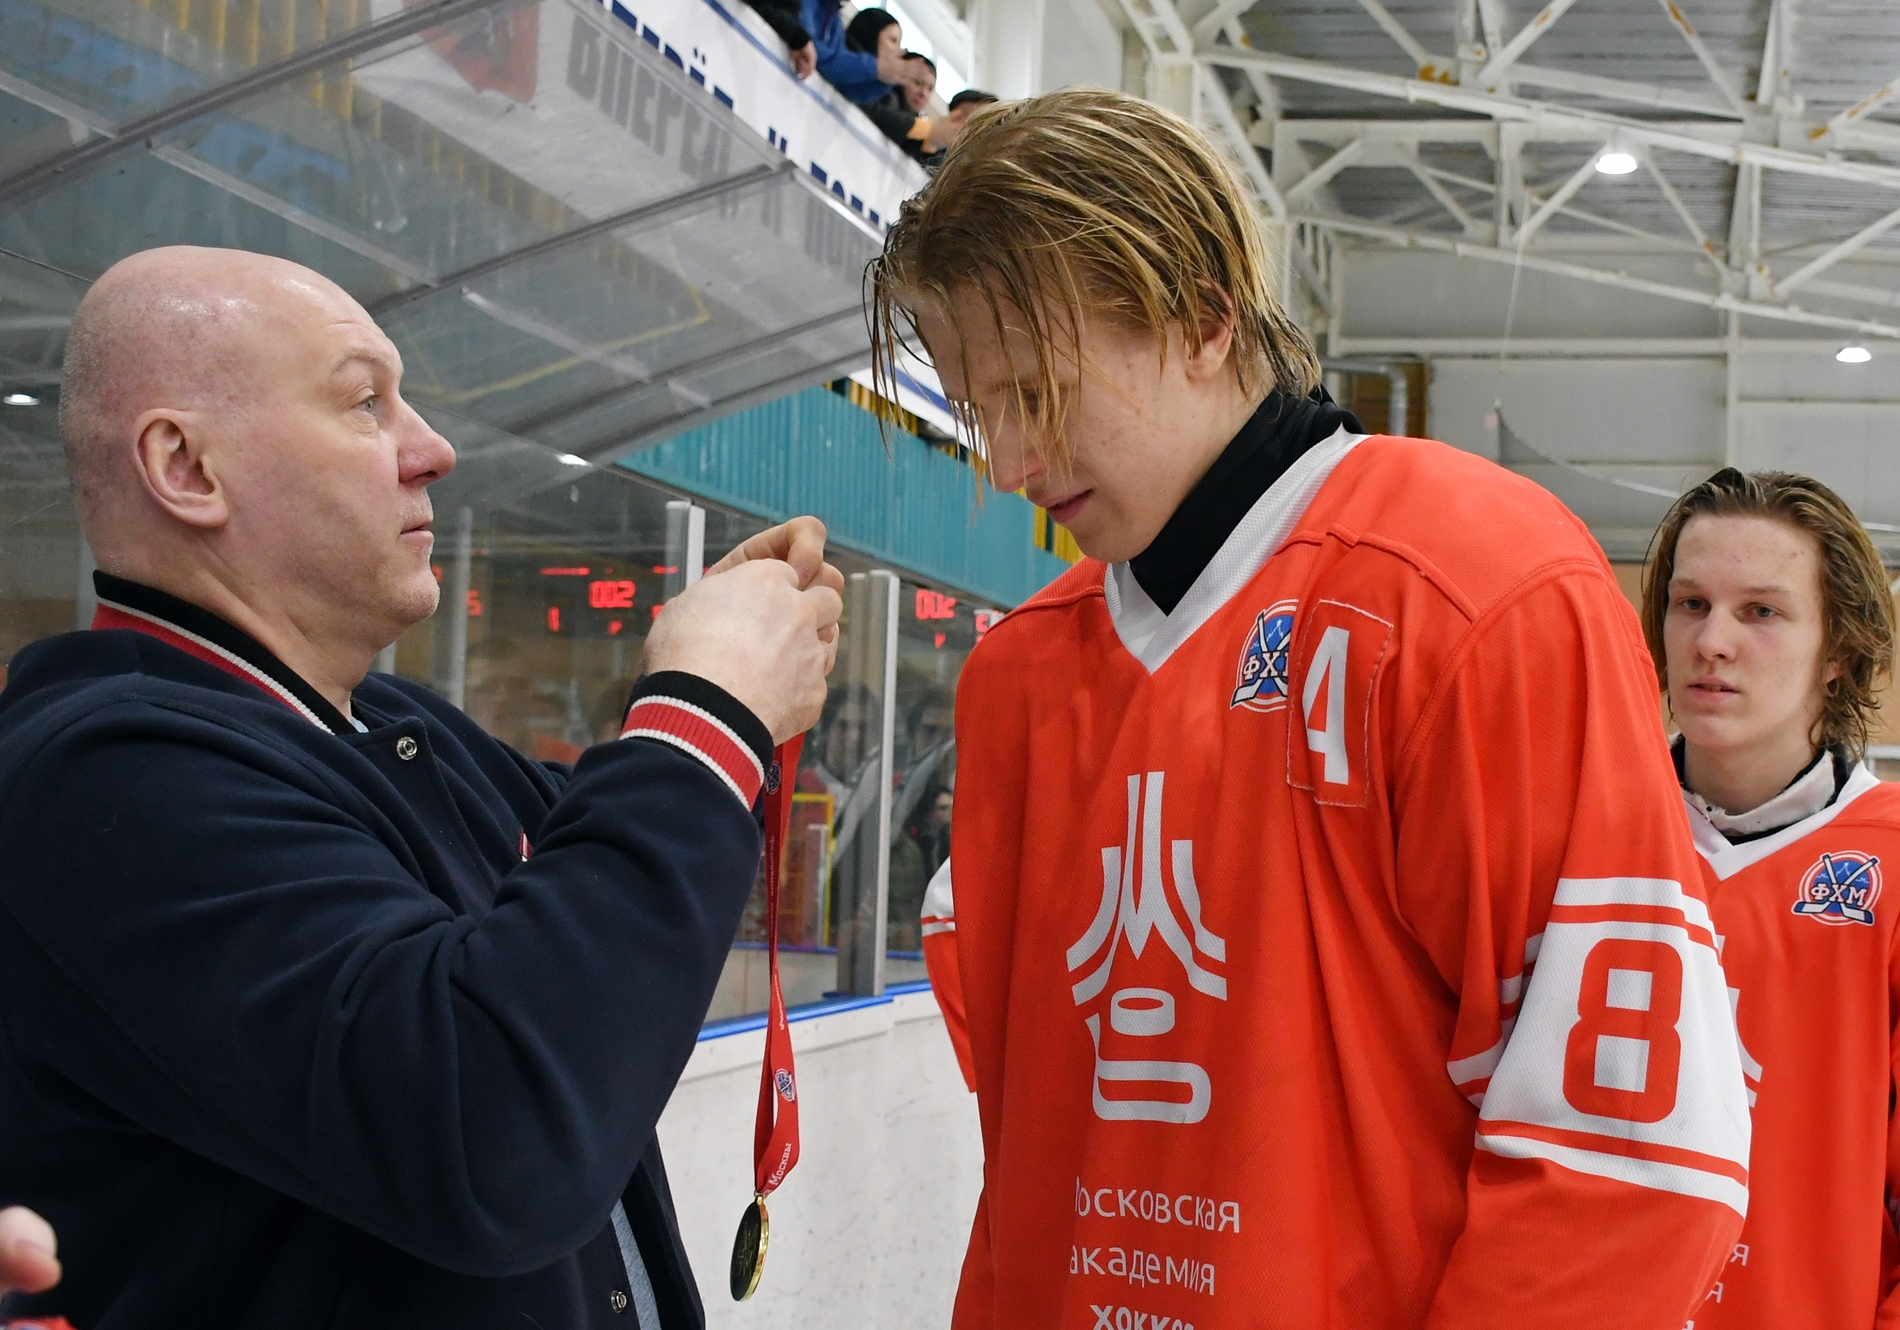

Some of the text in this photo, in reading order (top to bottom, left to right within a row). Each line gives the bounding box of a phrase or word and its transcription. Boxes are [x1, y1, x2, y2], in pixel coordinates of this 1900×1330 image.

[1242, 650, 1289, 680] ФХ
[1810, 883, 1867, 906] ФХМ
[1562, 937, 1684, 1124] 8
[768, 1142, 792, 1186] Москвы
[1074, 1176, 1240, 1234] осковская
[1069, 1244, 1215, 1296] академия
